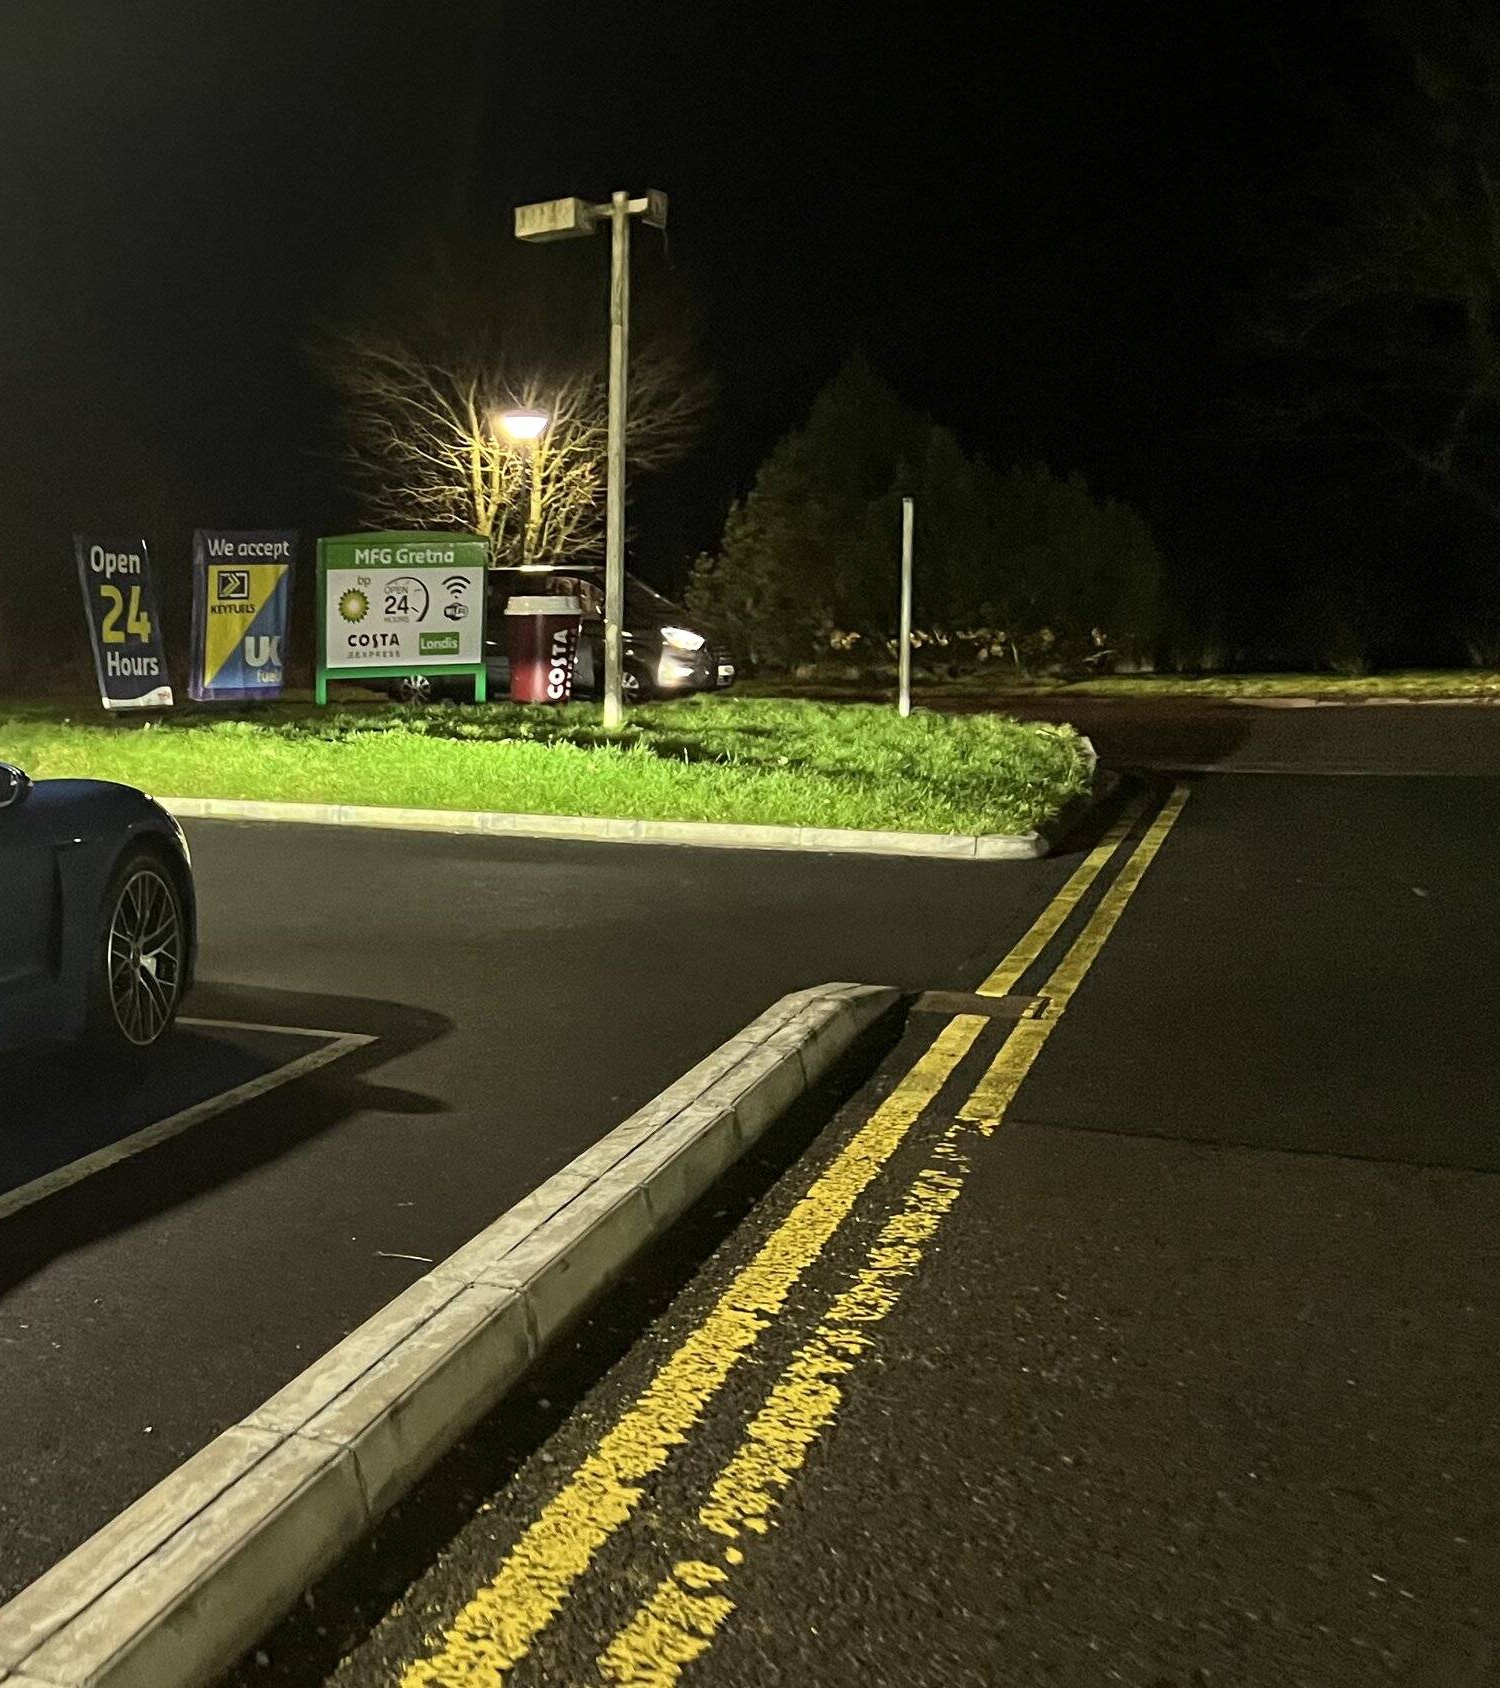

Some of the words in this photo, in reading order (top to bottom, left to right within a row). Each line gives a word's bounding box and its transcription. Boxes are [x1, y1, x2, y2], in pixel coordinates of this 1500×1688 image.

[207, 538, 234, 557] We
[238, 540, 290, 559] accept
[355, 548, 392, 564] MFG
[396, 549, 455, 563] Gretna
[90, 545, 141, 579] Open
[357, 576, 371, 587] bp
[100, 584, 151, 643] 24
[211, 604, 255, 614] KEYFUELS
[384, 595, 409, 614] 24
[348, 633, 400, 648] COSTA
[420, 637, 458, 649] Londis
[107, 651, 159, 677] Hours
[547, 629, 569, 699] COSTA
